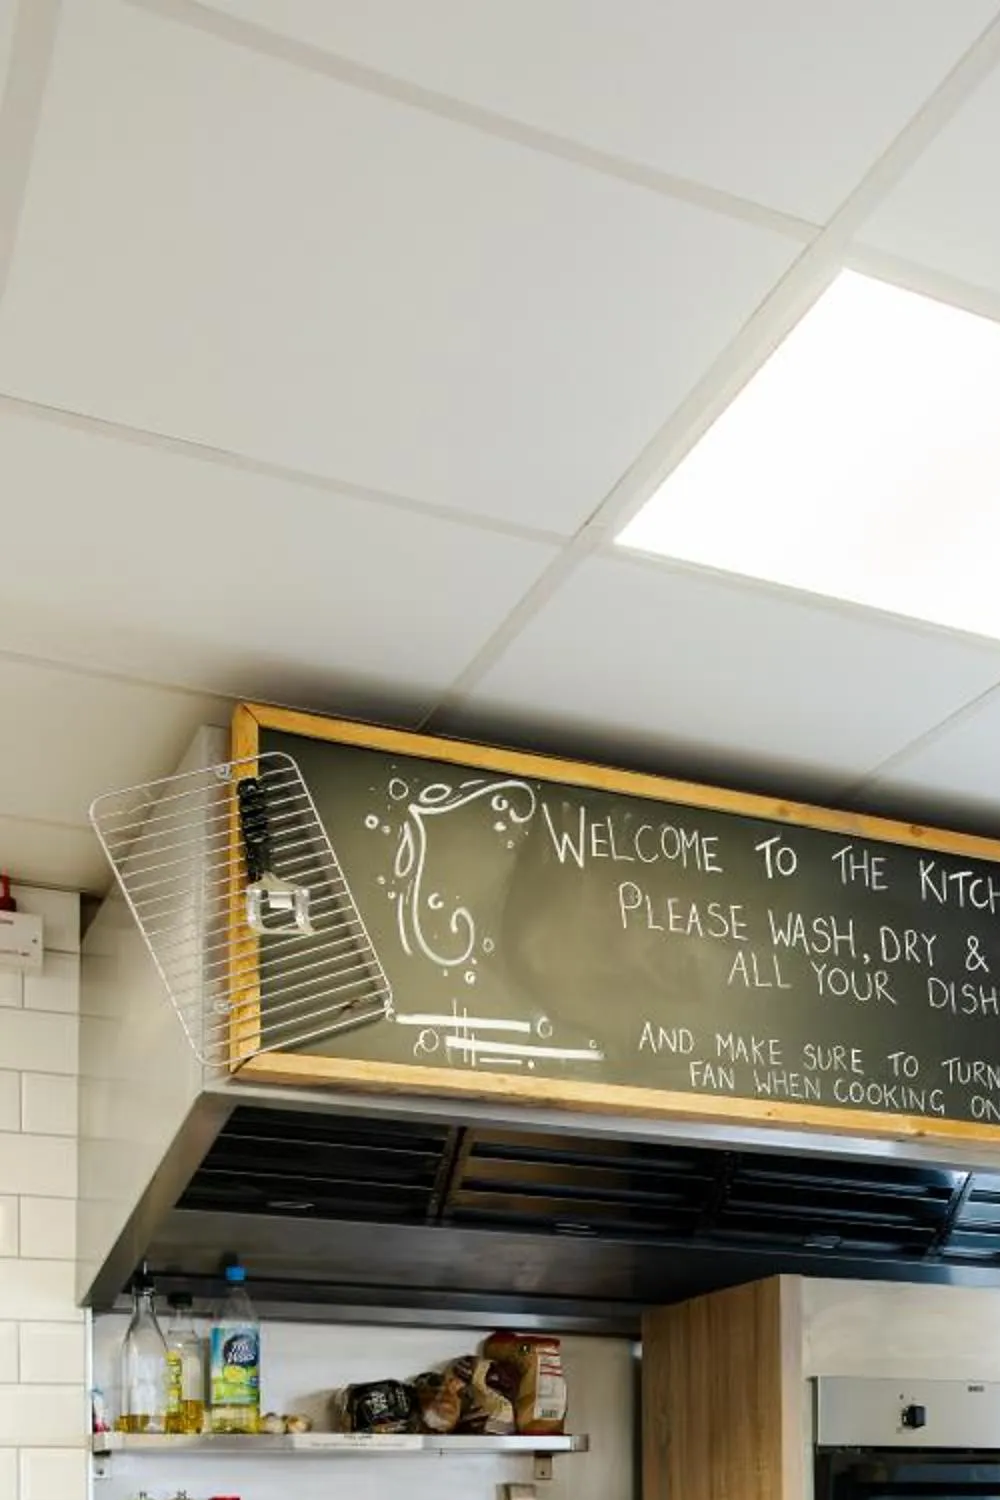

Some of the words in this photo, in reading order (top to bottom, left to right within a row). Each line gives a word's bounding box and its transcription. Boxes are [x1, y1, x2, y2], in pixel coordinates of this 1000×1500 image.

[542, 803, 723, 873] WELCOME
[755, 836, 798, 879] TO
[831, 845, 888, 891] THE
[618, 882, 748, 941] PLEASE
[879, 925, 937, 967] DRY
[965, 935, 990, 973] &
[727, 951, 792, 989] ALL
[811, 961, 897, 1006] YOUR
[638, 1021, 695, 1054] AND
[715, 1032, 783, 1066] MAKE
[803, 1043, 865, 1075] SURE
[887, 1051, 919, 1078] TO
[941, 1057, 1000, 1091] TURN
[689, 1061, 736, 1090] FAN
[753, 1069, 822, 1100] WHEN
[833, 1078, 945, 1115] COOKING
